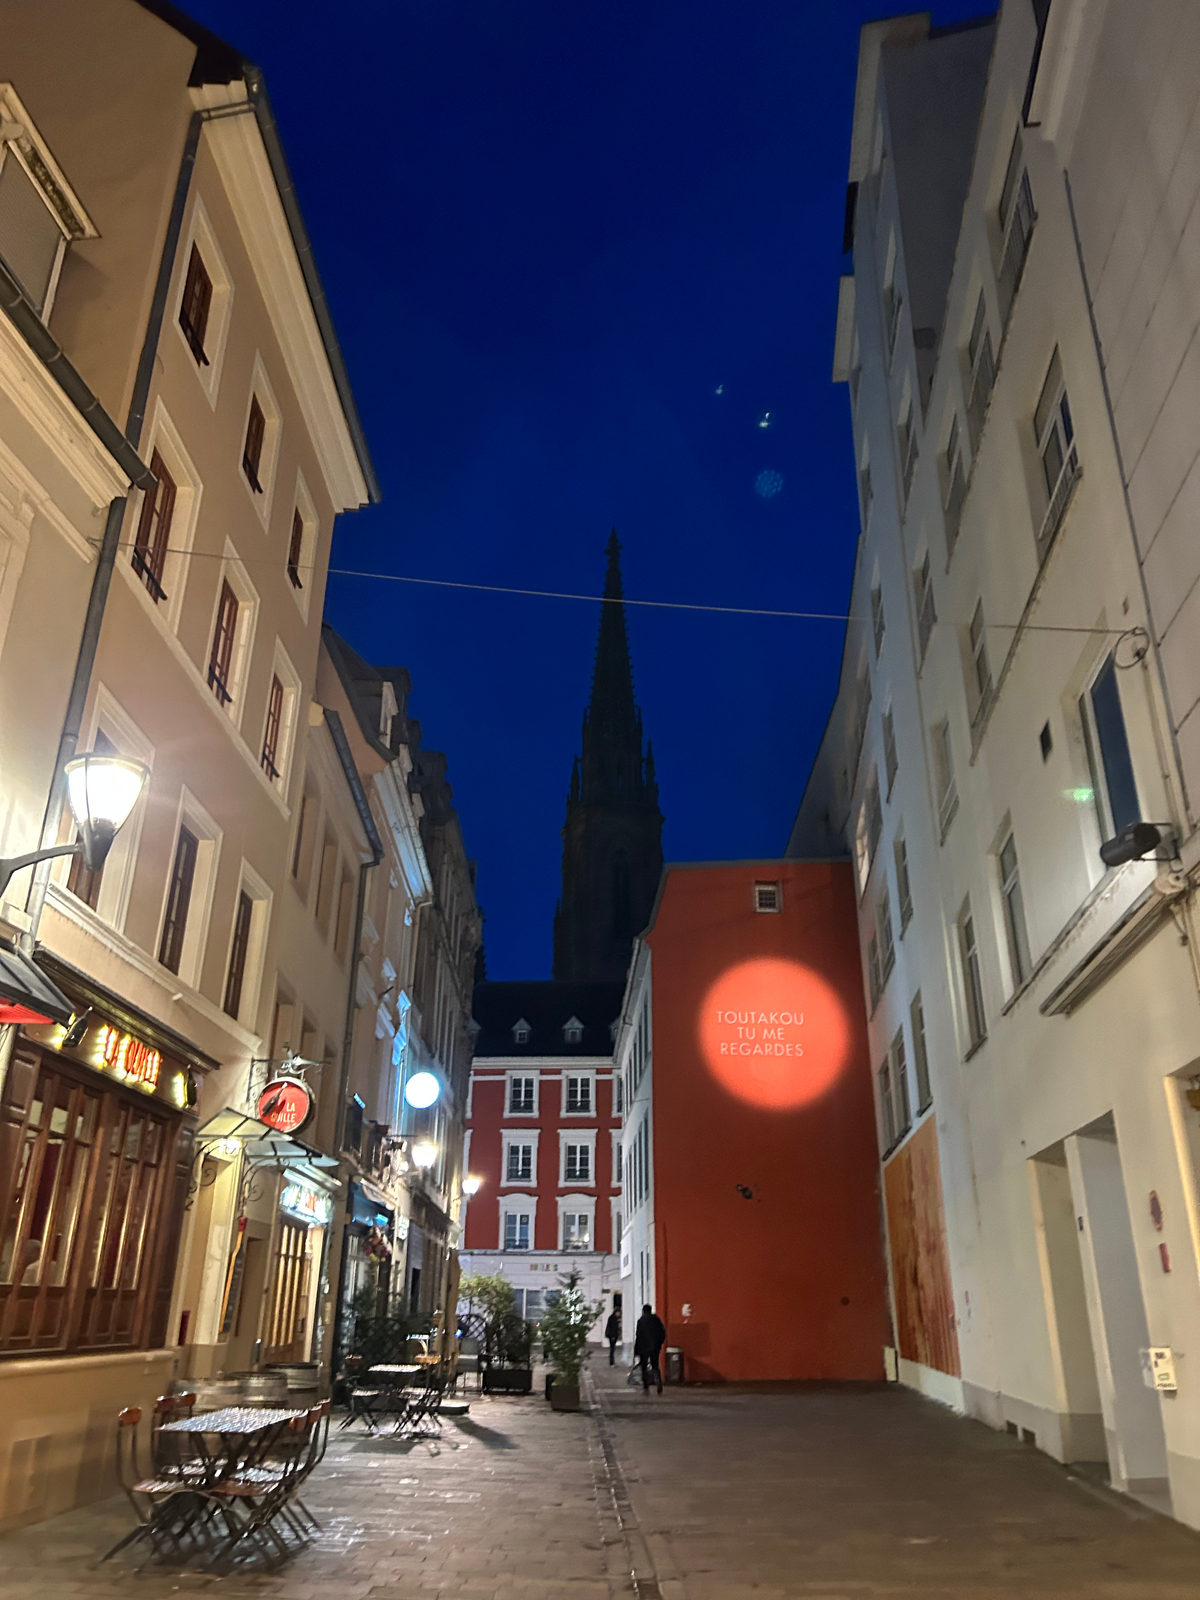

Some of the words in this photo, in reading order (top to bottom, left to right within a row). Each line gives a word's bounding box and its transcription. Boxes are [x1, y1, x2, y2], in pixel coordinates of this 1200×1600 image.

[717, 1011, 804, 1025] TOUTAKOU
[737, 1026, 756, 1040] TU
[763, 1027, 785, 1040] ME
[720, 1042, 804, 1057] REGARDES
[286, 1102, 296, 1112] LA
